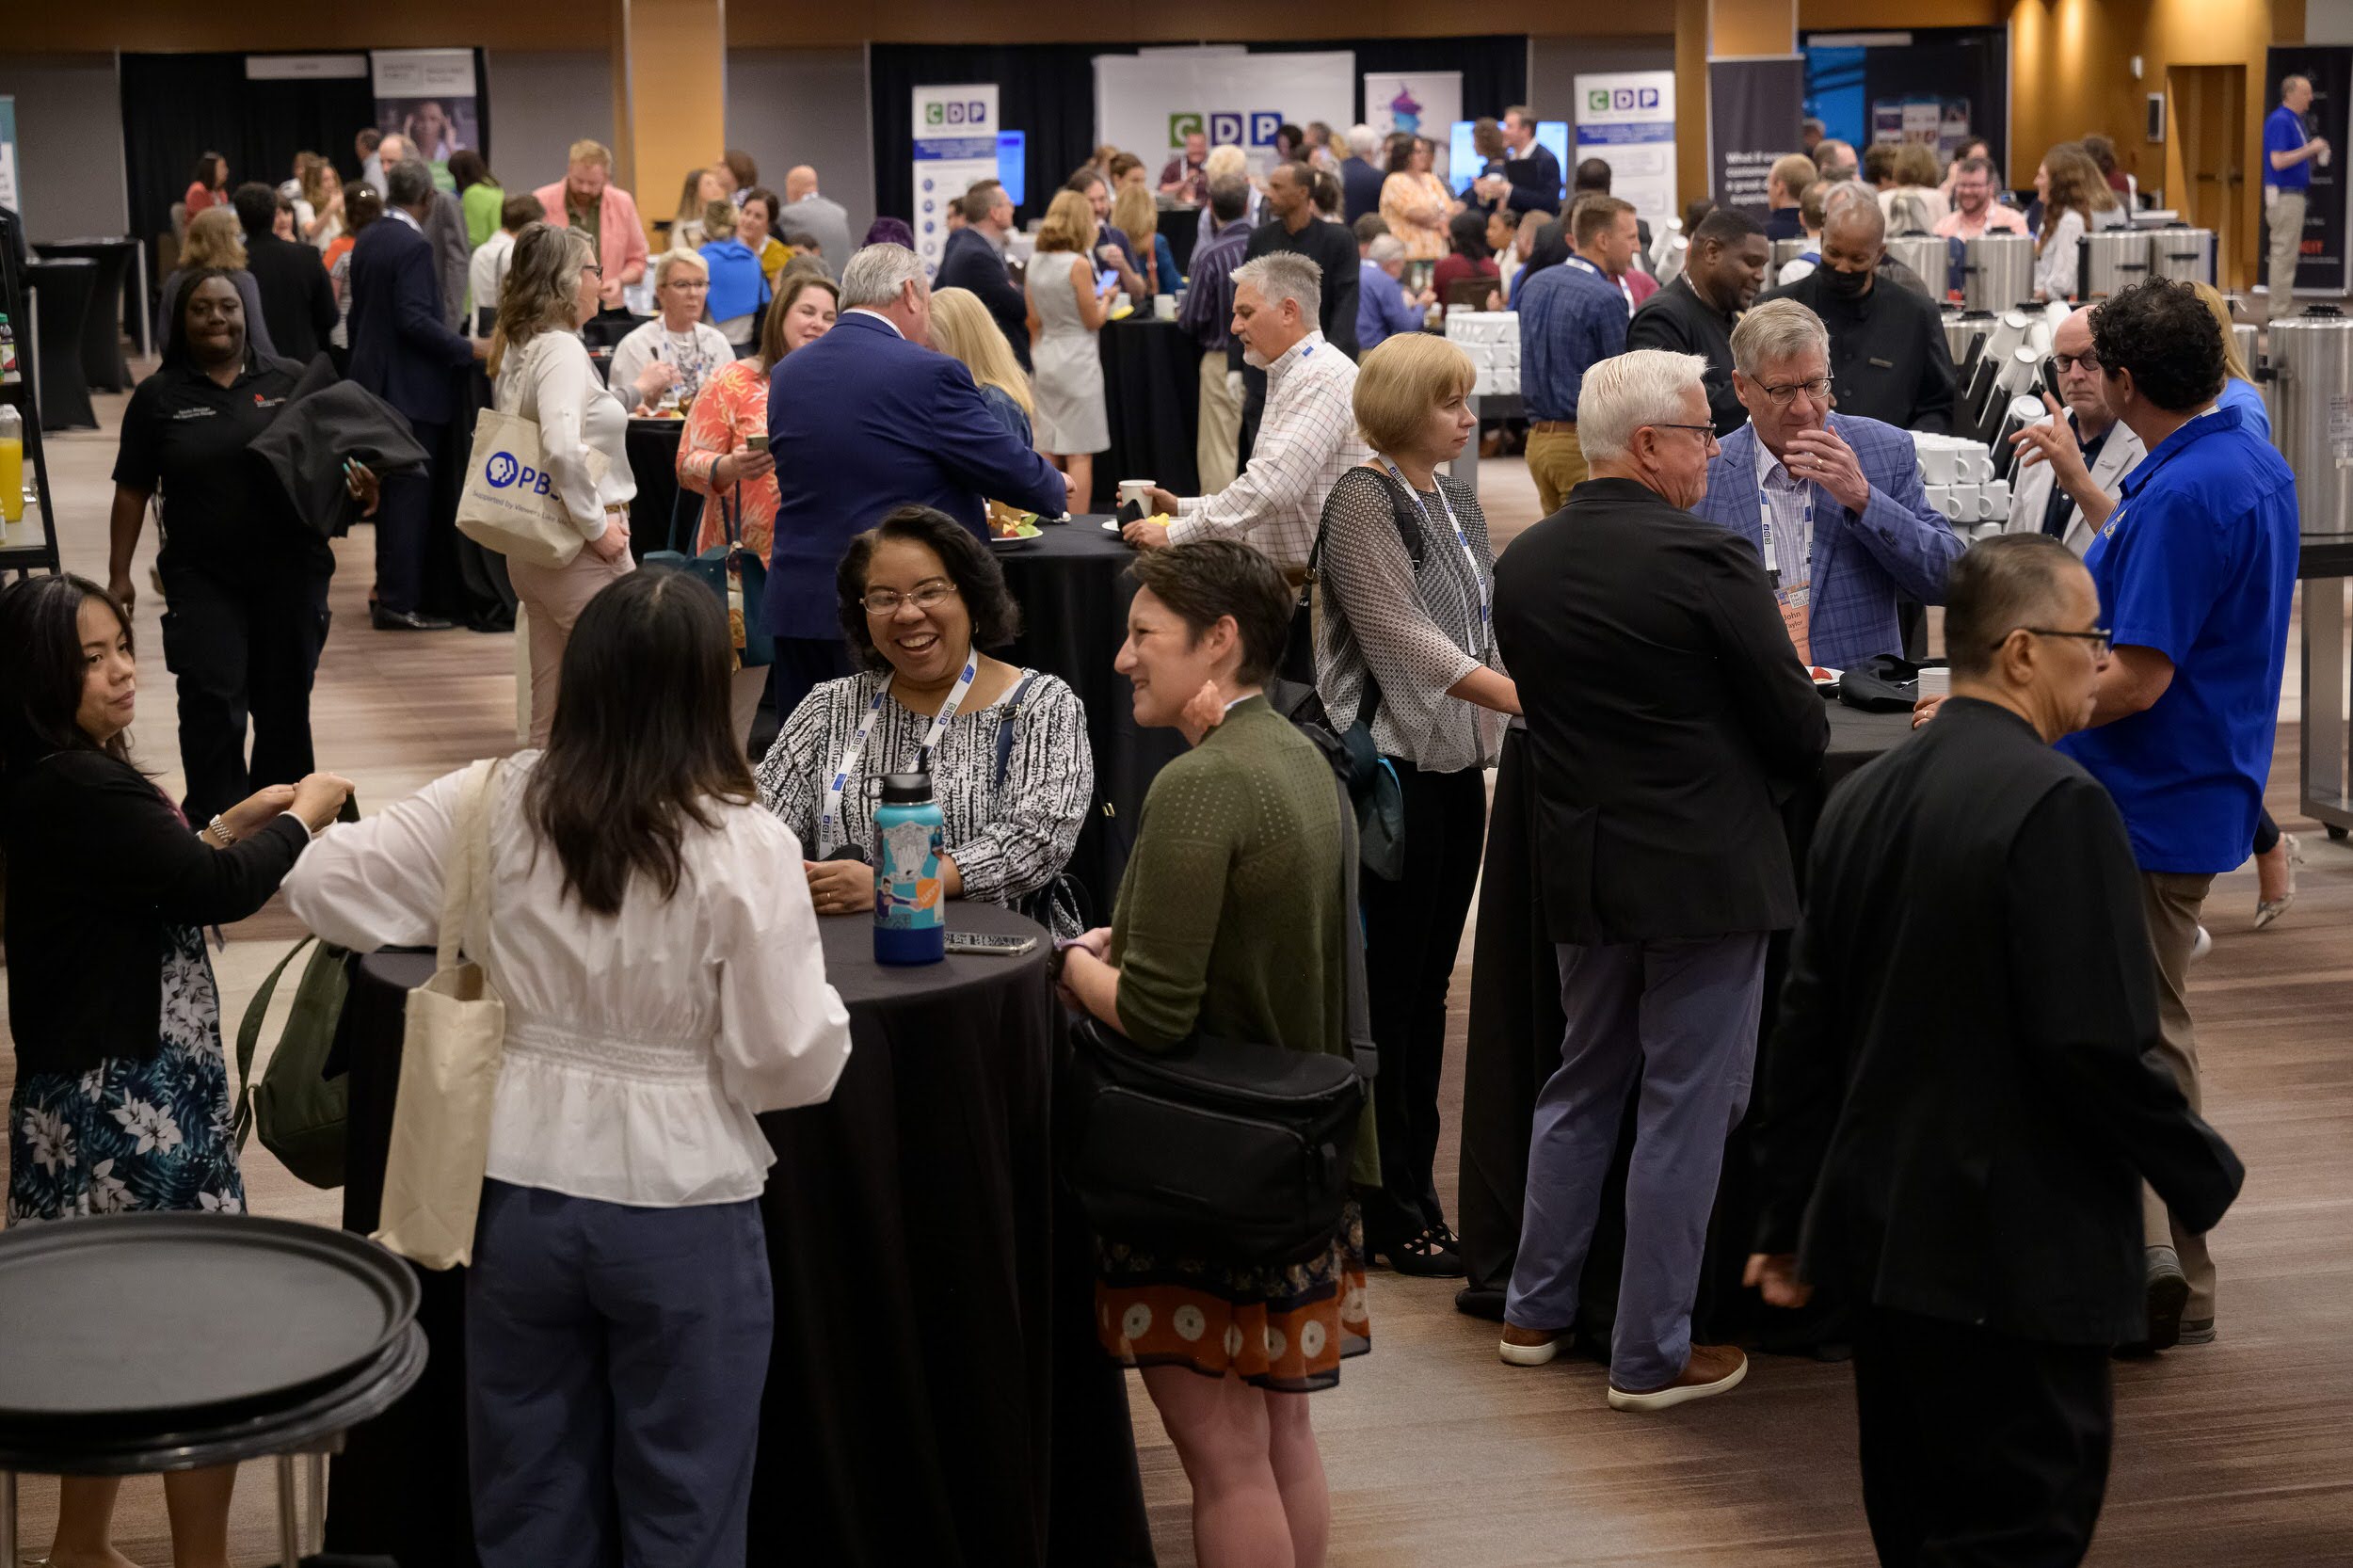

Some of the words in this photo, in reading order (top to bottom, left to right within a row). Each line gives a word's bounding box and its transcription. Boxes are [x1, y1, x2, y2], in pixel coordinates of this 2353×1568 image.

[1587, 88, 1659, 110] CDP
[926, 102, 984, 124] CDP
[1170, 113, 1282, 146] CDP
[472, 490, 504, 506] Supported
[504, 500, 514, 509] by
[514, 504, 540, 517] Viewers
[541, 511, 556, 522] Like
[1763, 523, 1771, 545] CDP
[1784, 611, 1801, 620] John
[938, 702, 957, 726] CDP
[850, 729, 866, 752] CDP
[822, 815, 831, 842] CDP
